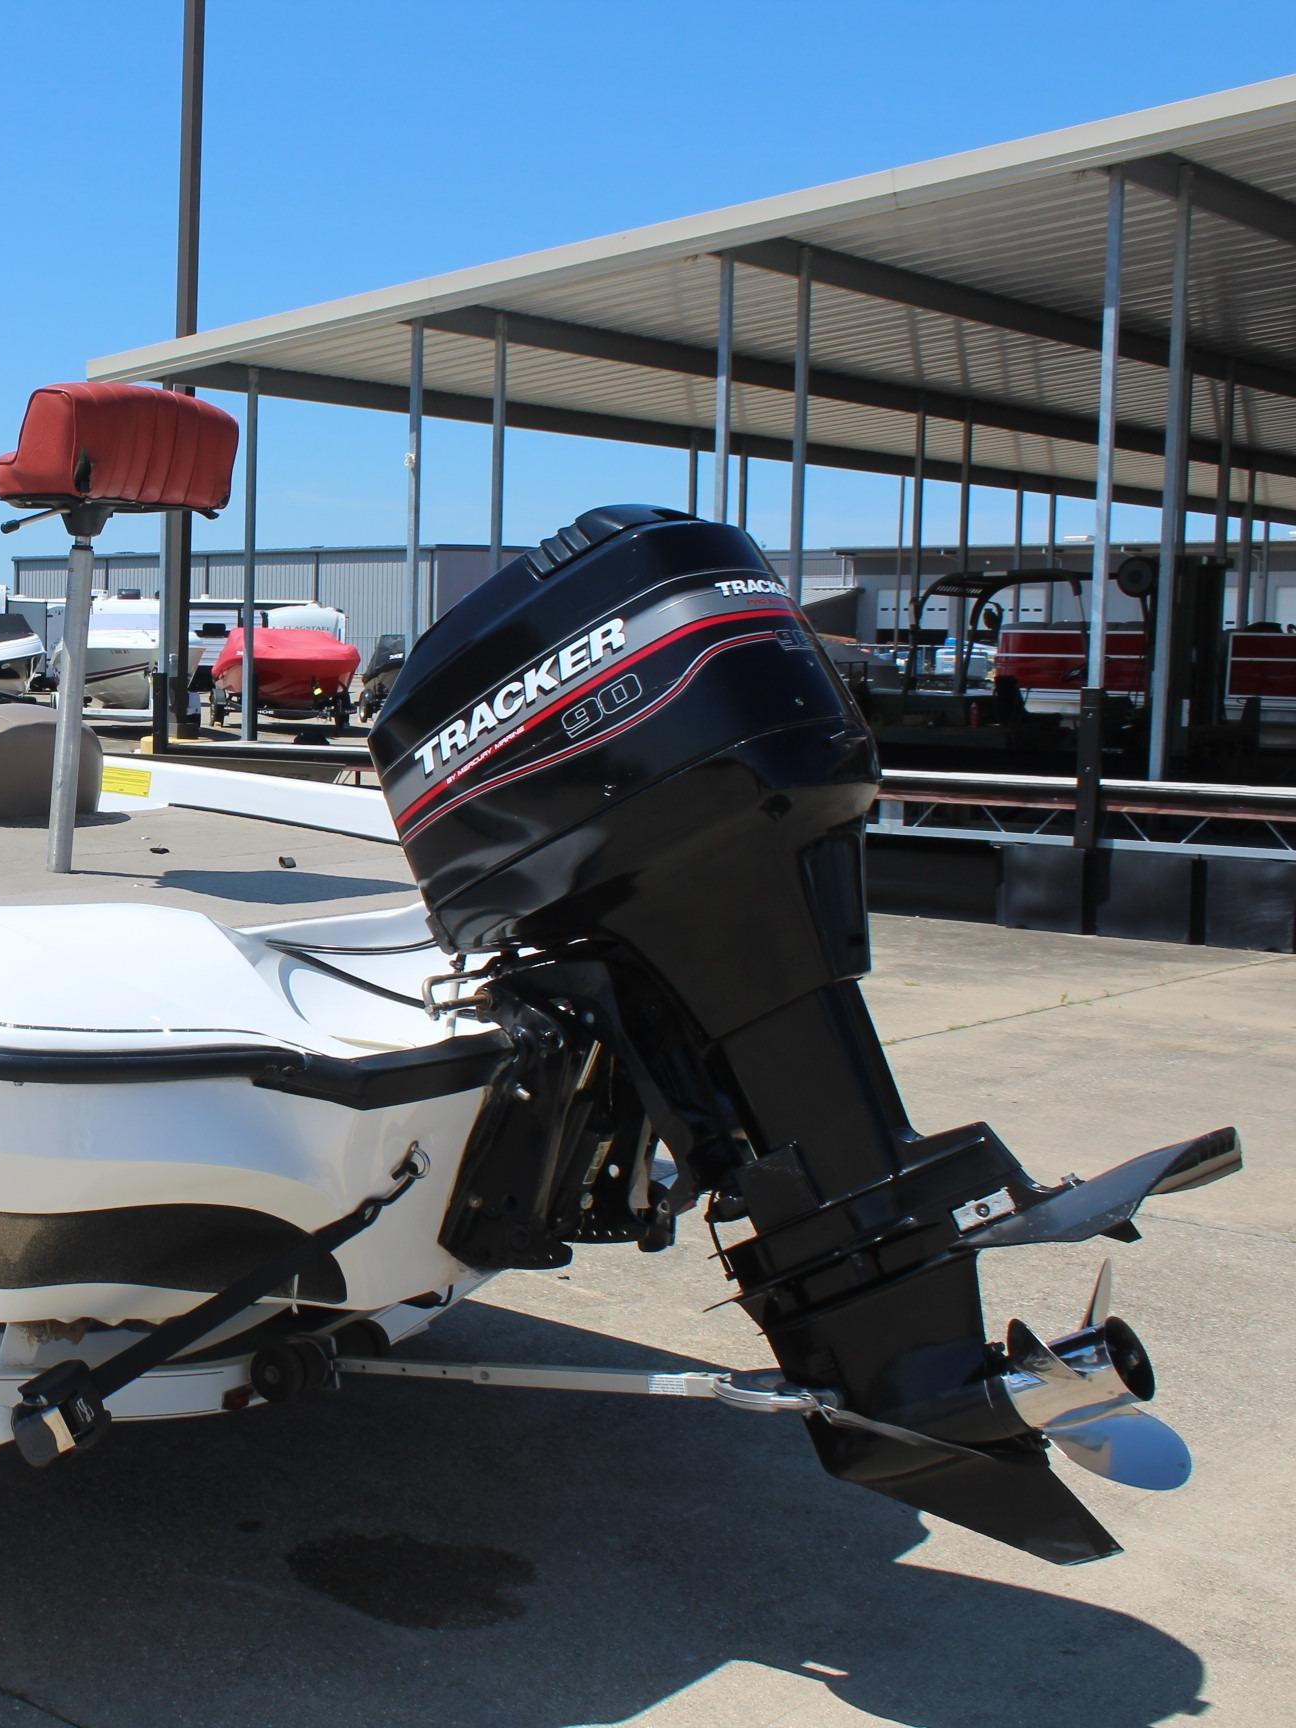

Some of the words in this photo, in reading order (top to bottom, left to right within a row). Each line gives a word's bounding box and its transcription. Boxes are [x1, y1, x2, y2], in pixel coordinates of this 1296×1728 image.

[414, 617, 627, 776] TRACKER
[561, 673, 643, 739] 90
[457, 748, 492, 776] MERCURY
